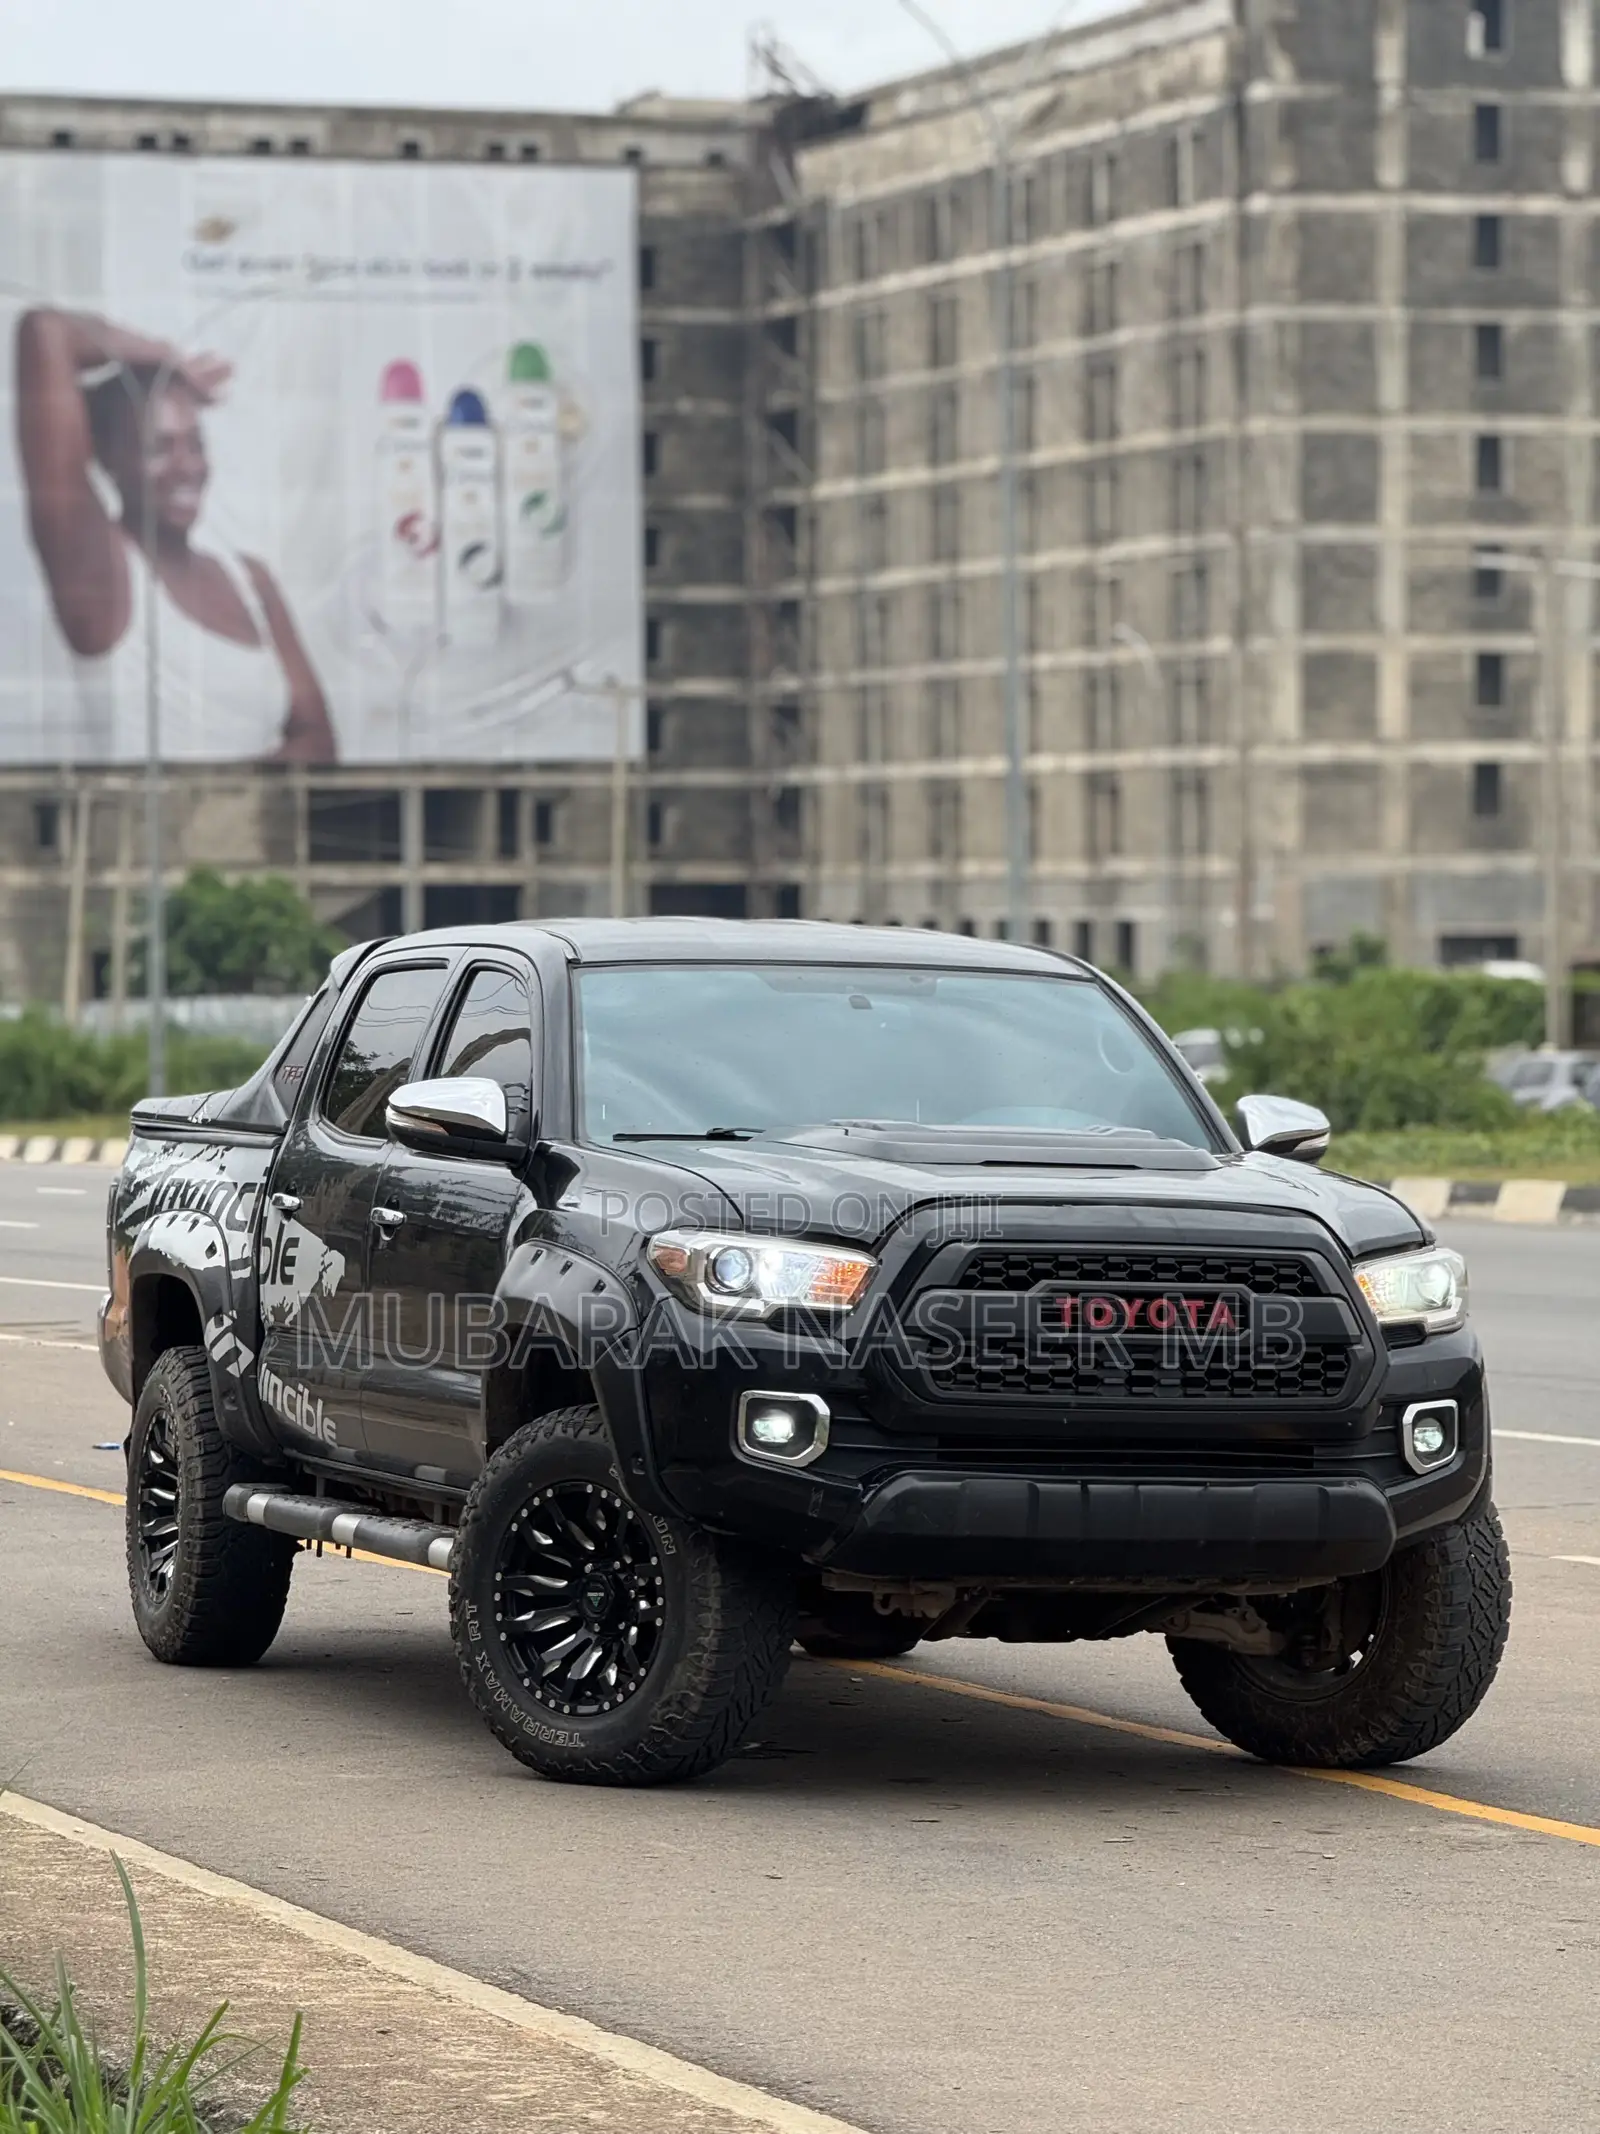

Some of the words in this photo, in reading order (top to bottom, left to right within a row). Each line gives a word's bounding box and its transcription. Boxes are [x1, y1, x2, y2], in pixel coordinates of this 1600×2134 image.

[1055, 1296, 1237, 1331] TOYOTA
[465, 1599, 482, 1642] RT
[475, 1651, 587, 1748] TERRAMAX
